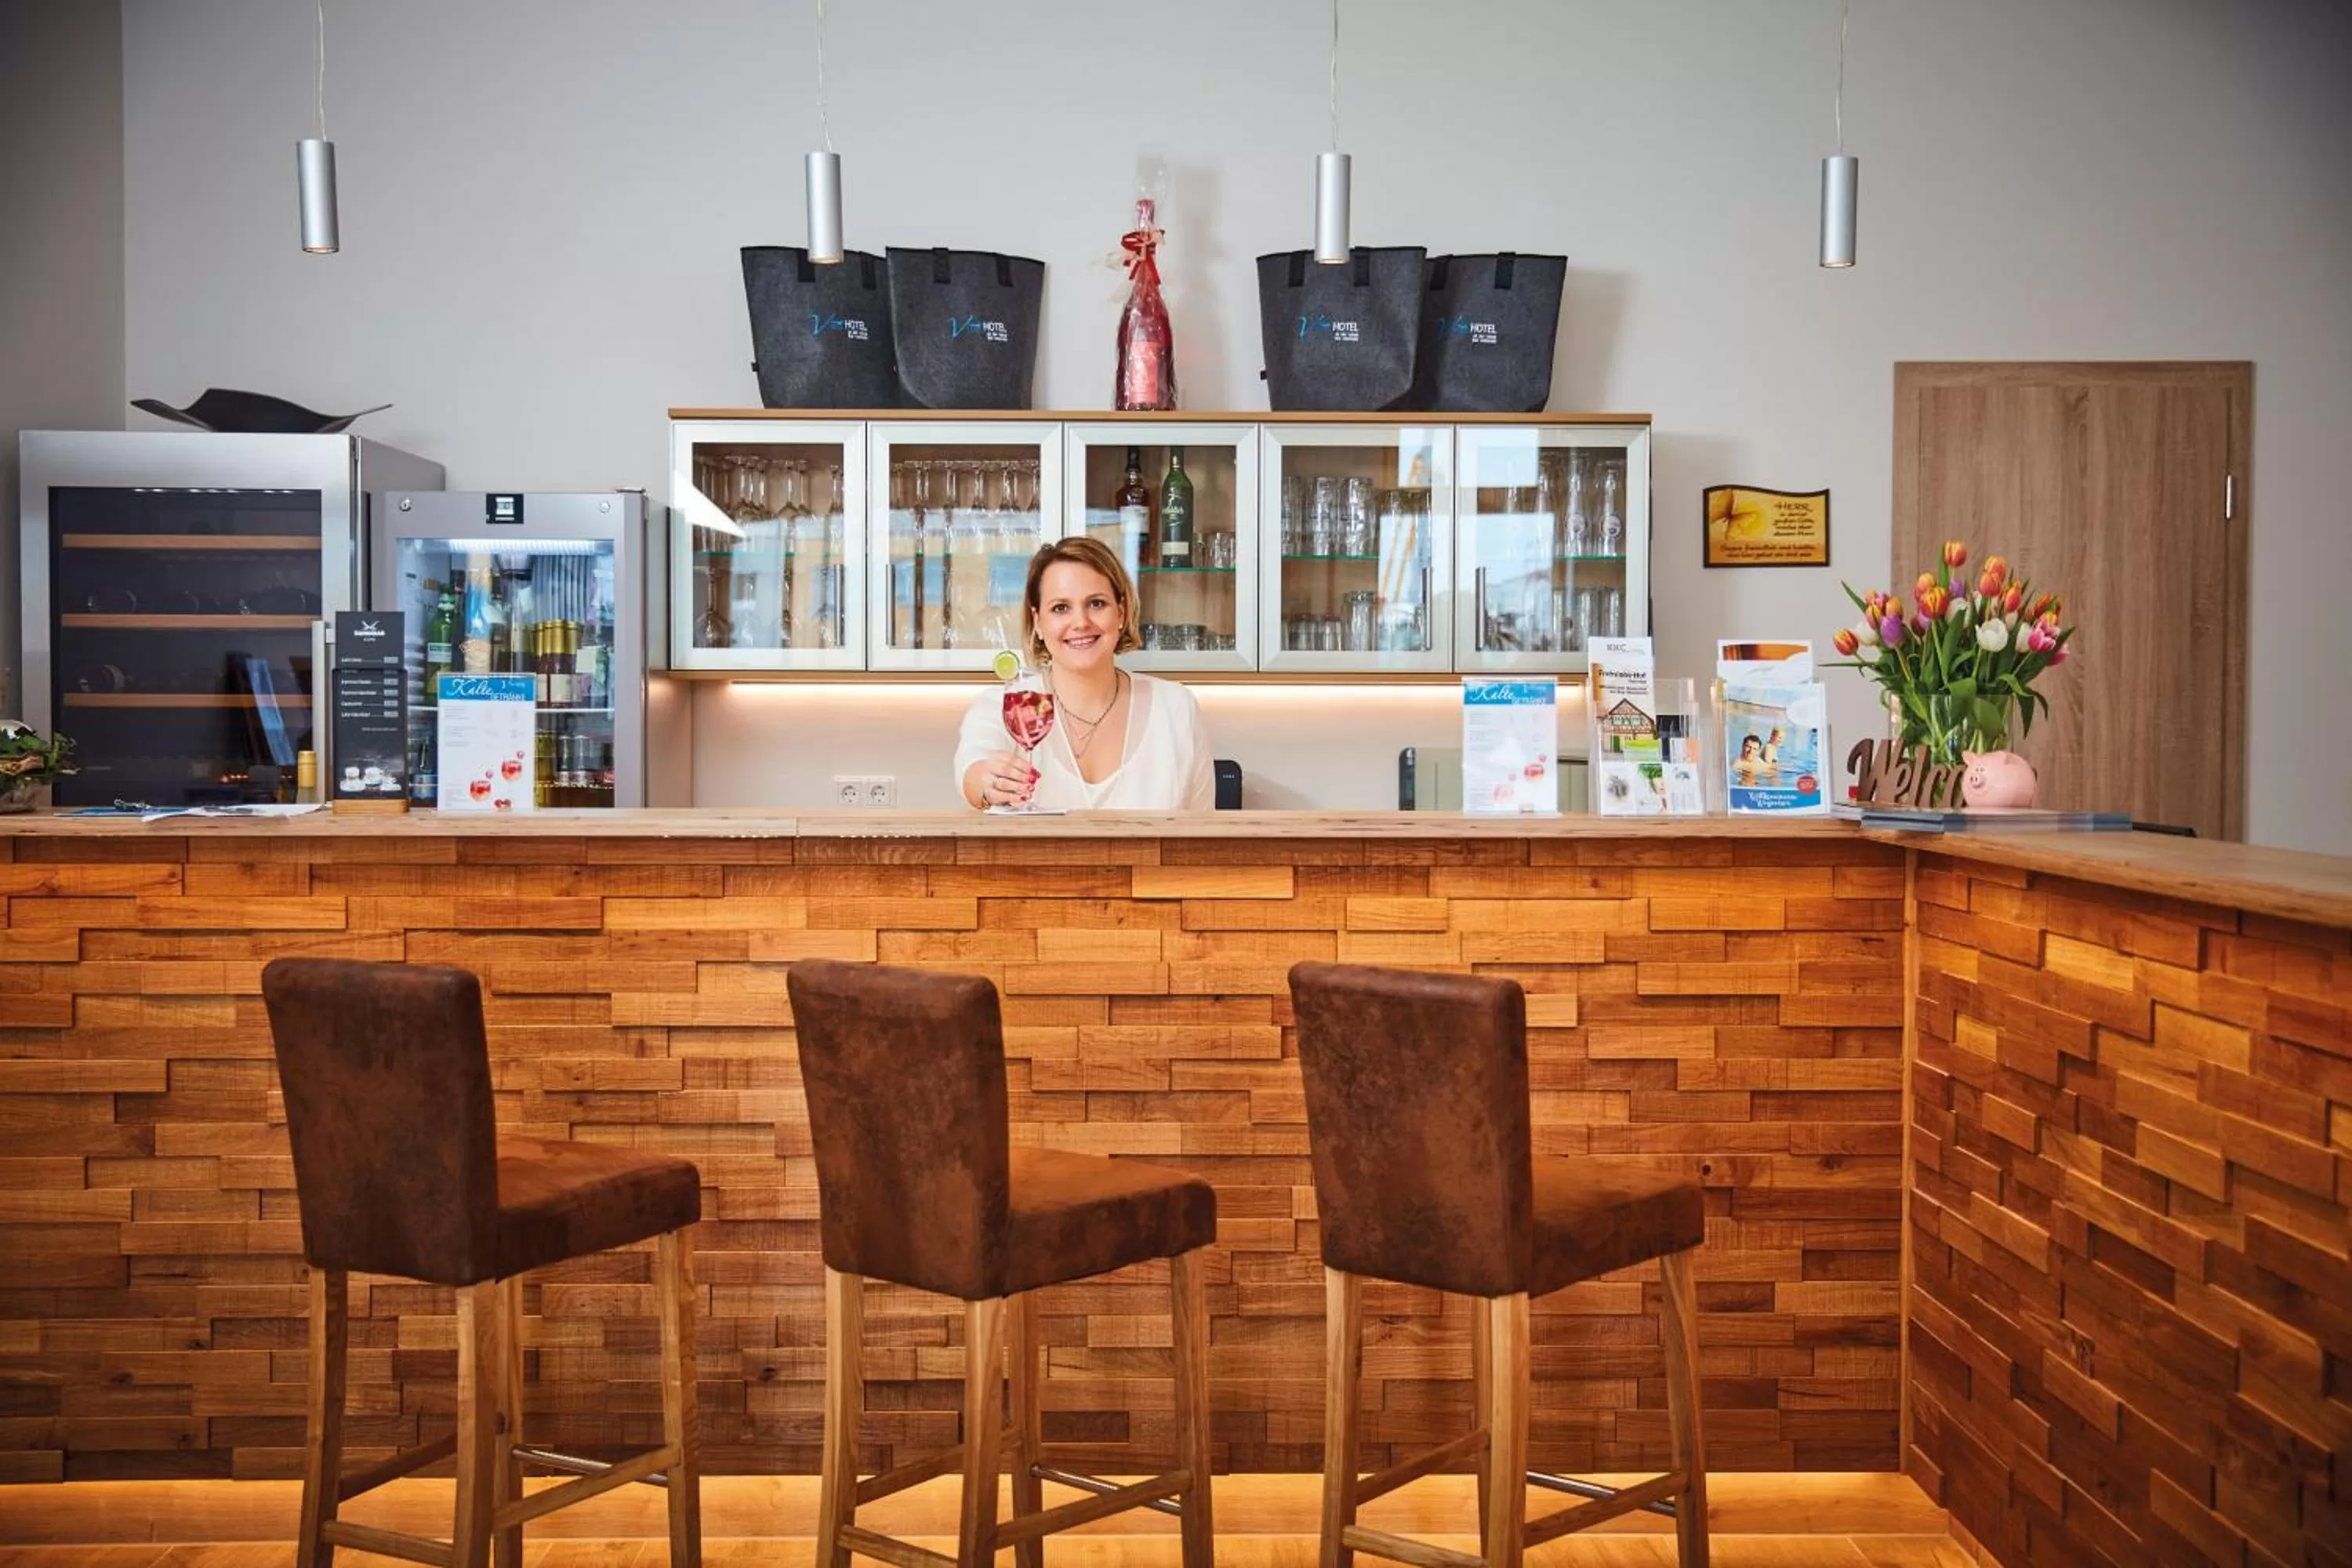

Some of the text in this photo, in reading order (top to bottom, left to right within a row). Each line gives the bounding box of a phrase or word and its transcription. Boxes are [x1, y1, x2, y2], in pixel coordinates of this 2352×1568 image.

[1333, 321, 1359, 332] HOTEL
[1470, 323, 1497, 333] HOTEL
[445, 678, 492, 695] Kalte
[1468, 684, 1514, 701] Kalte
